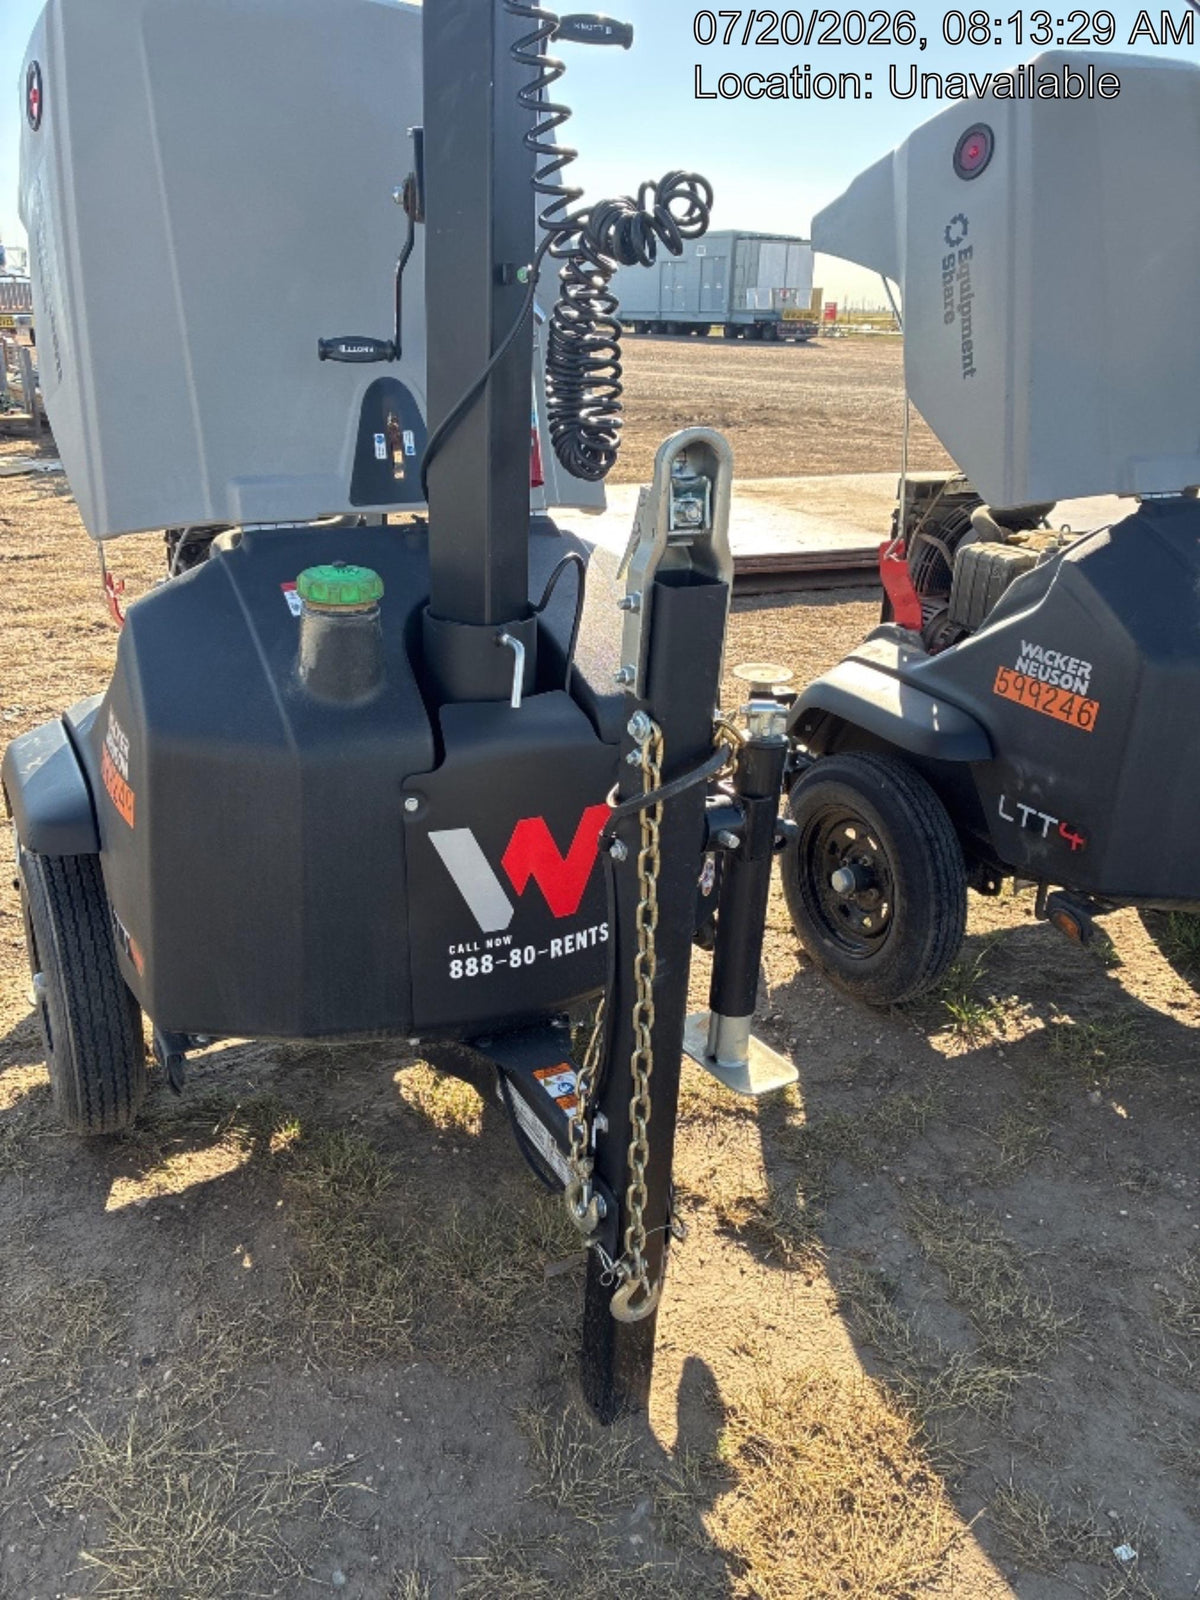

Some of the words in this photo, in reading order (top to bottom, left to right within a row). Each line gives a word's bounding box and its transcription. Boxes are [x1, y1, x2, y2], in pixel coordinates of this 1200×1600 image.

[942, 252, 956, 326] Share
[957, 245, 977, 380] Equipment
[1014, 655, 1090, 696] NEUSON
[1020, 640, 1093, 680] WACKER
[996, 668, 1095, 727] 599246
[998, 794, 1085, 851] LTT4
[449, 940, 481, 955] CALL
[486, 934, 514, 949] NOW
[449, 922, 609, 979] 888-80-RENTS
